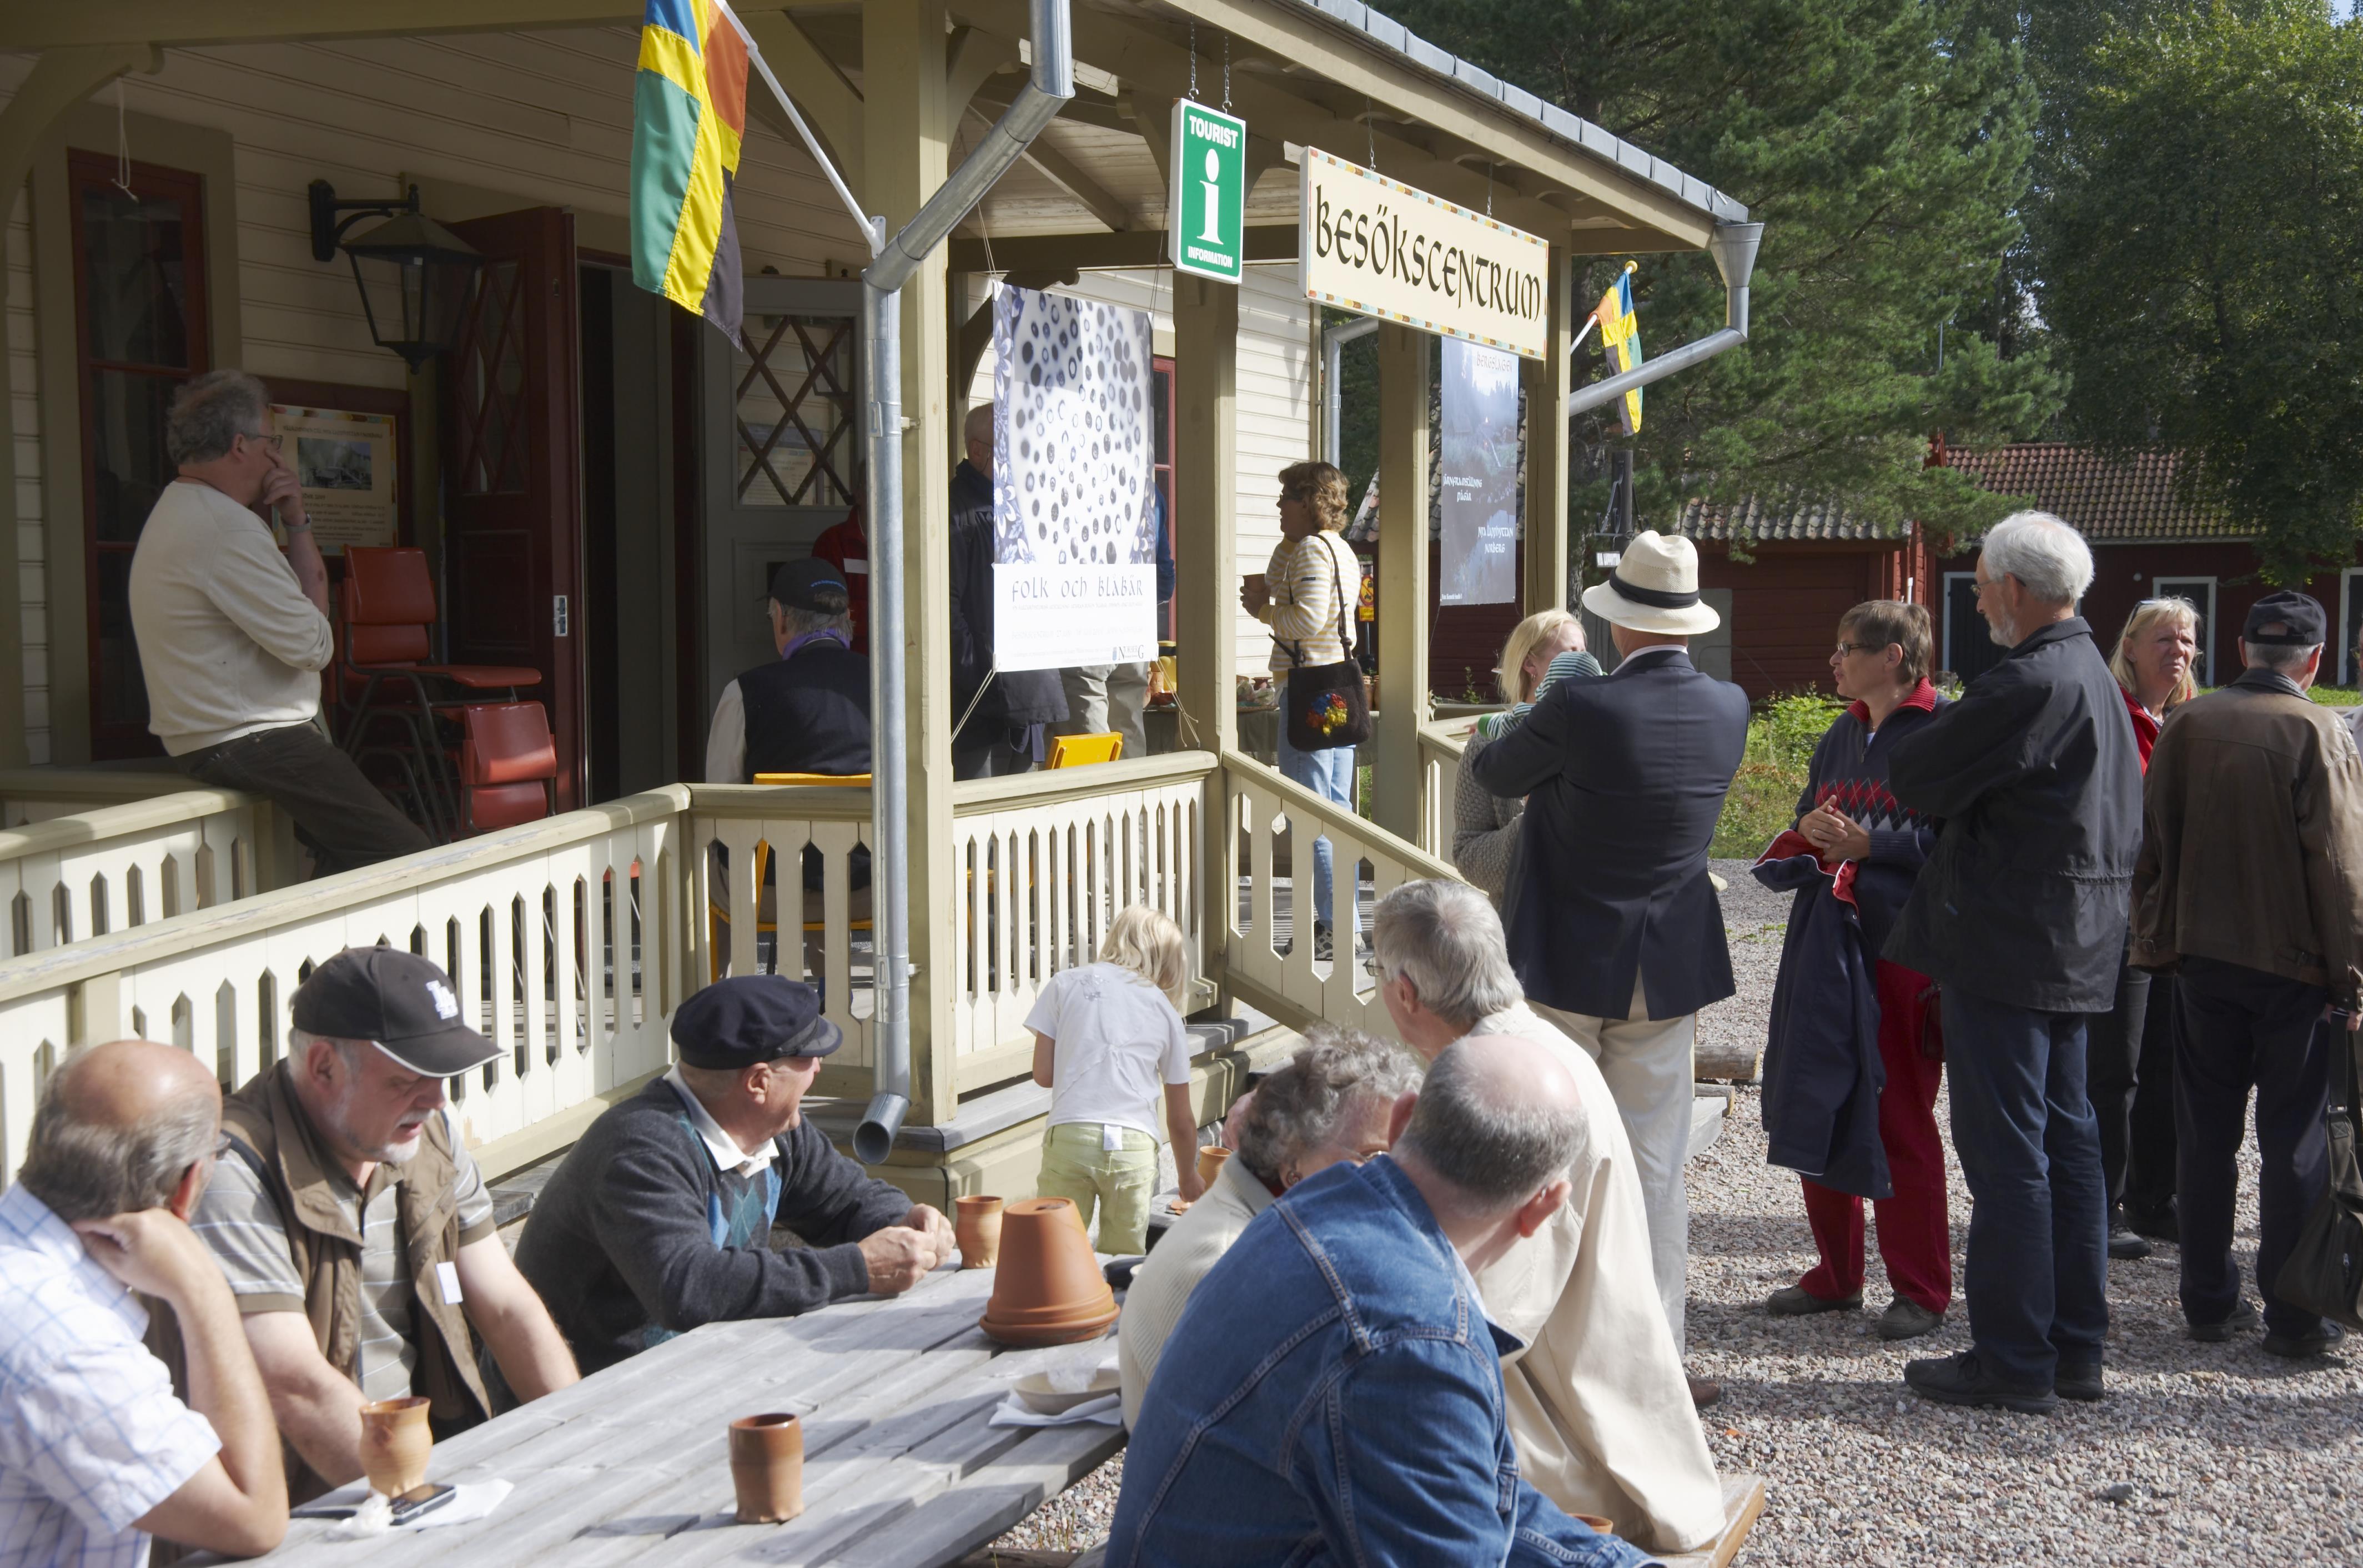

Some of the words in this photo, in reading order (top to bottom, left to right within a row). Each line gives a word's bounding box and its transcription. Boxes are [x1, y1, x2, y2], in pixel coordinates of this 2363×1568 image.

[1189, 115, 1238, 149] TOURIST
[1187, 245, 1233, 269] INFORMATION
[1315, 184, 1541, 321] BESÖKSCENTRUM
[1457, 489, 1472, 502] PÅGÅR
[1478, 526, 1487, 537] NYA
[1485, 542, 1505, 554] NORBERG
[1012, 576, 1049, 602] FOLK
[1061, 576, 1087, 598] OCH
[1098, 574, 1143, 597] BLÅBÄR
[426, 979, 459, 1019] LA
